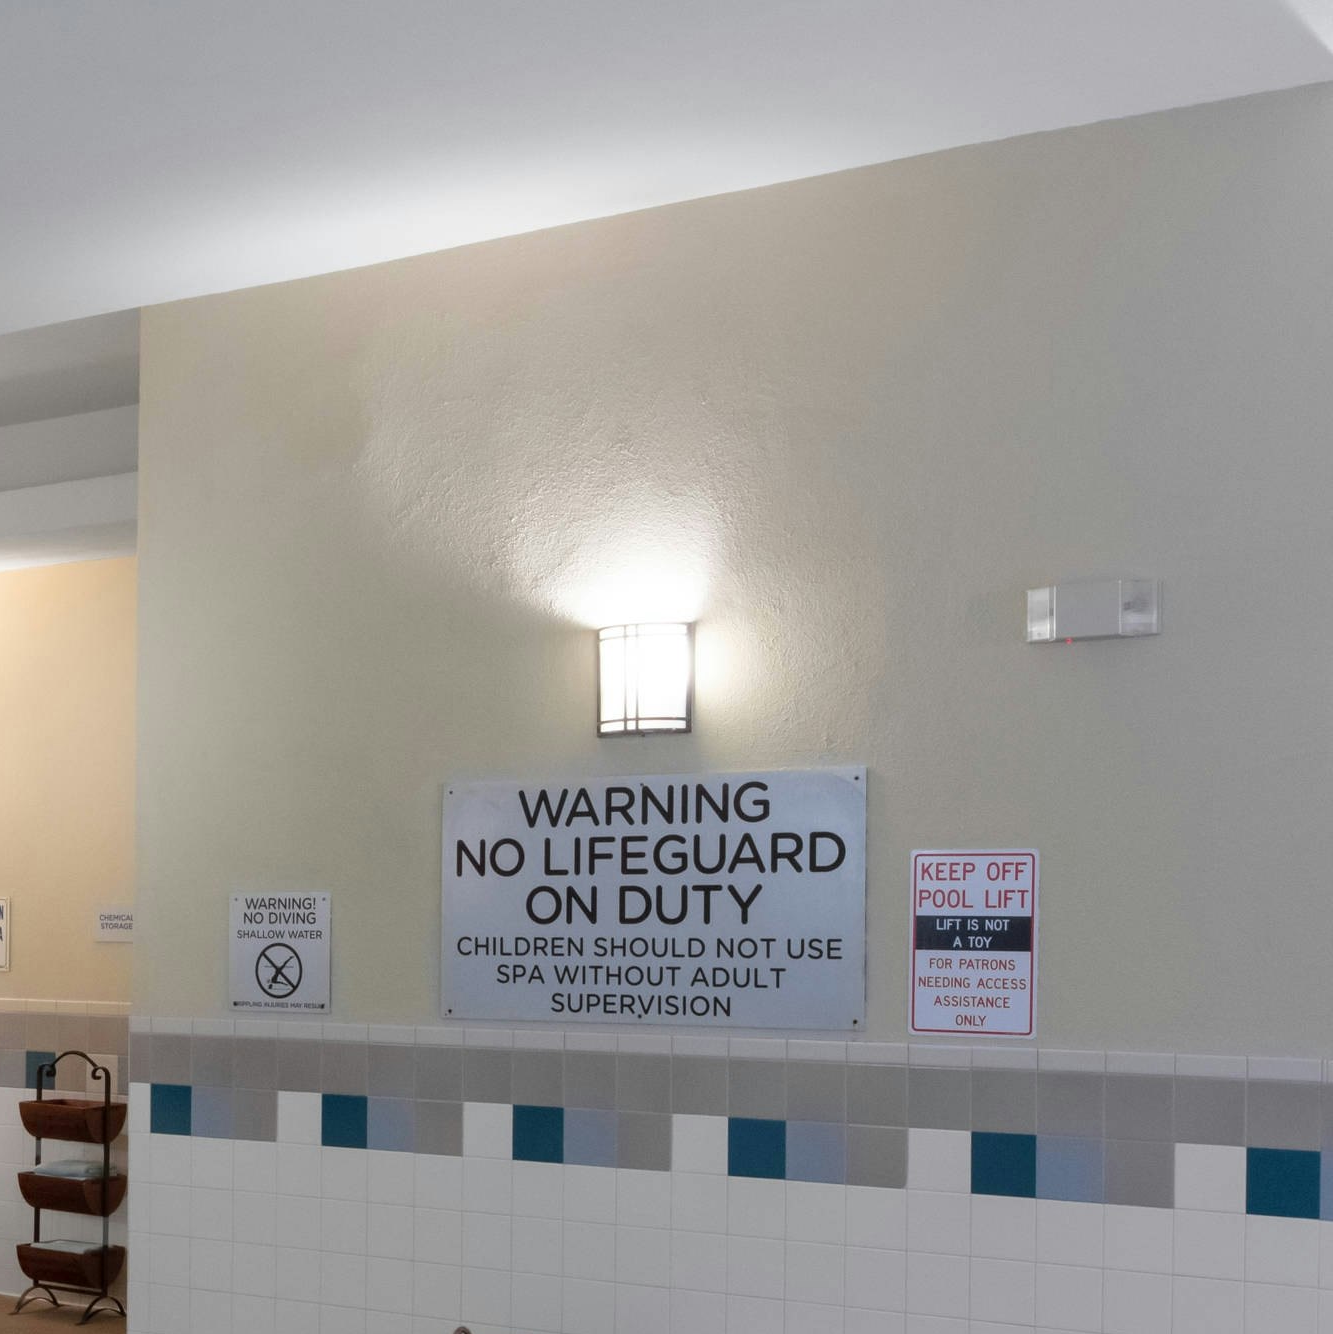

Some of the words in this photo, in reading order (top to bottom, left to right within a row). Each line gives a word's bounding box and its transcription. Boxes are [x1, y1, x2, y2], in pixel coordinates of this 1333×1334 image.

[519, 781, 771, 828] WARNING
[456, 838, 525, 877] NO
[544, 831, 847, 876] LIFEGUARD
[921, 862, 976, 881] KEEP
[986, 862, 1027, 881] OFF
[245, 897, 317, 910] WARNING!
[525, 885, 598, 926] ON
[618, 884, 763, 925] DUTY
[918, 889, 974, 908] POOL
[985, 889, 1029, 909] LIFT
[243, 912, 264, 925] NO
[268, 912, 317, 925] DIVING
[936, 919, 962, 931] LIFT
[967, 919, 979, 931] IS
[985, 919, 1010, 931] NOT
[100, 922, 133, 930] STORAGE
[236, 929, 285, 940] SHALLOW
[287, 930, 323, 940] WATER
[456, 937, 584, 957] CHILDREN
[593, 937, 706, 959] SHOULD
[716, 938, 777, 960] NOT
[786, 938, 844, 960] USE
[953, 936, 962, 948] A
[968, 936, 993, 948] TOY
[929, 958, 952, 969] FOR
[959, 958, 1016, 971] PATRONS
[496, 965, 544, 985] SPA
[554, 965, 681, 988] WITHOUT
[690, 967, 786, 989] ADULT
[918, 976, 970, 989] NEEDING
[976, 978, 1027, 990] ACCESS
[551, 993, 732, 1017] SUPERVISION
[934, 995, 1010, 1009] ASSISTANCE
[955, 1014, 987, 1027] ONLY
